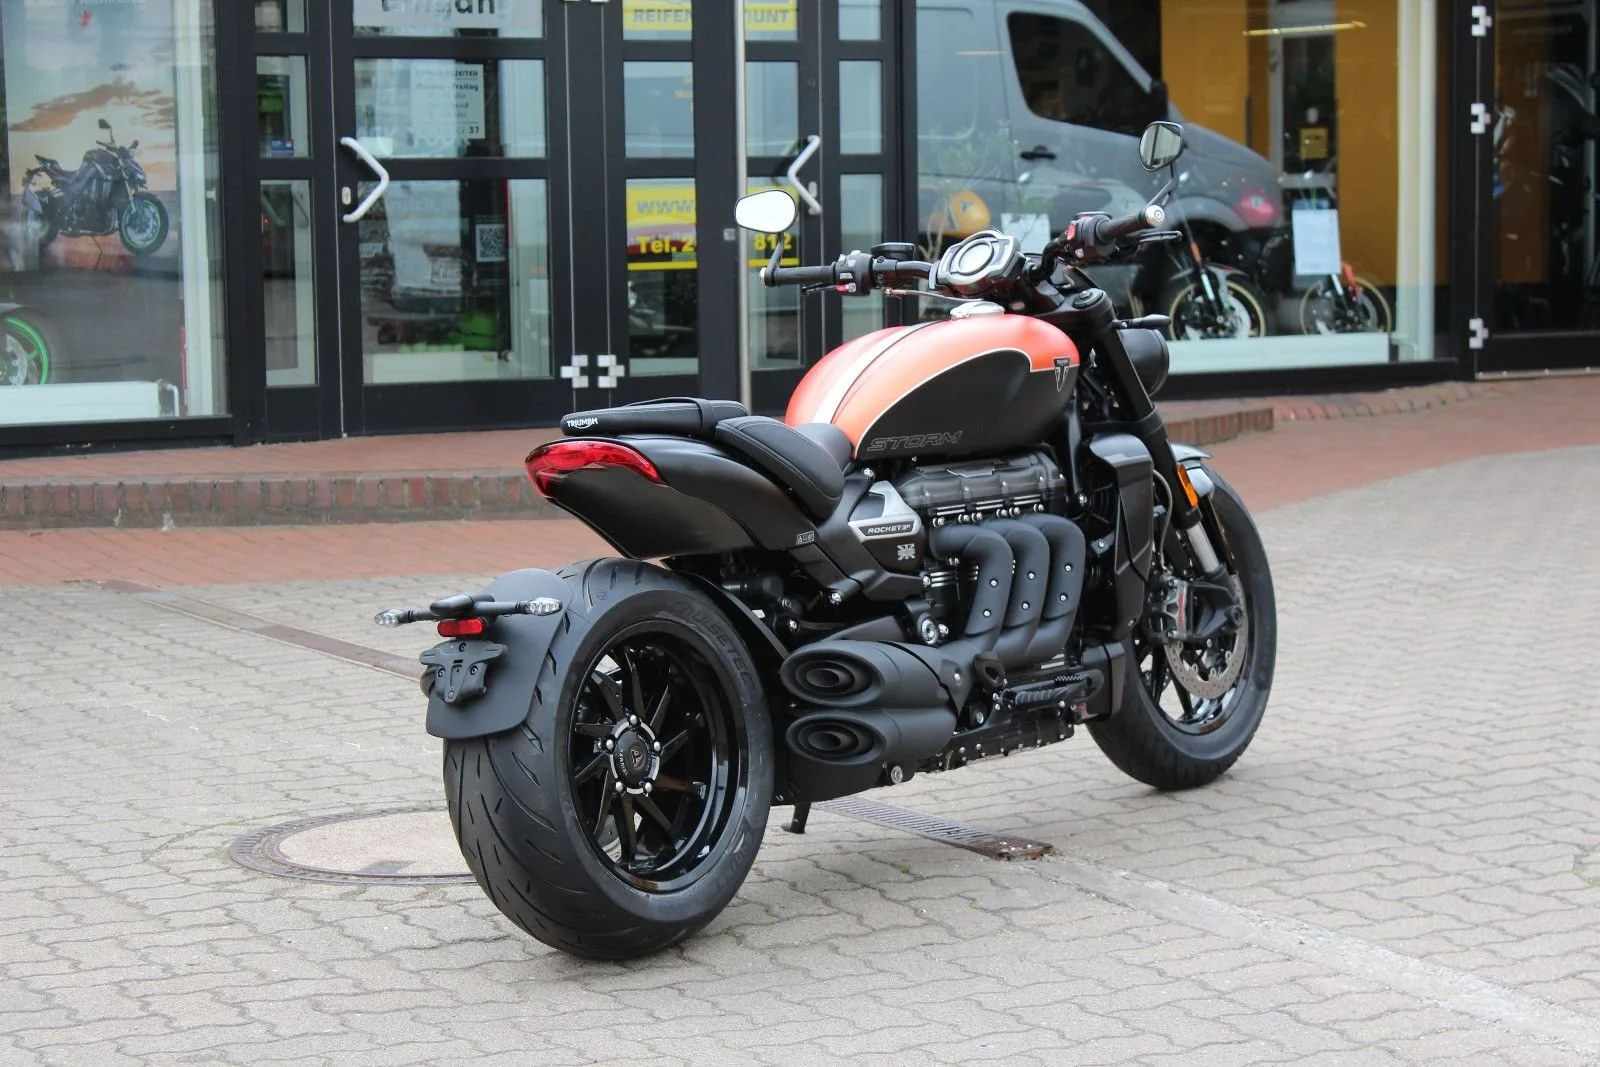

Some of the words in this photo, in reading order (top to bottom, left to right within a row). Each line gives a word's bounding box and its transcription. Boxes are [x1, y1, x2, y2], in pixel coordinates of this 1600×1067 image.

[746, 9, 789, 23] UNT
[469, 126, 479, 135] 37
[637, 235, 677, 254] Tel.
[566, 417, 599, 429] TRIUMPH
[867, 430, 963, 452] STORM
[867, 524, 902, 534] ROCKET
